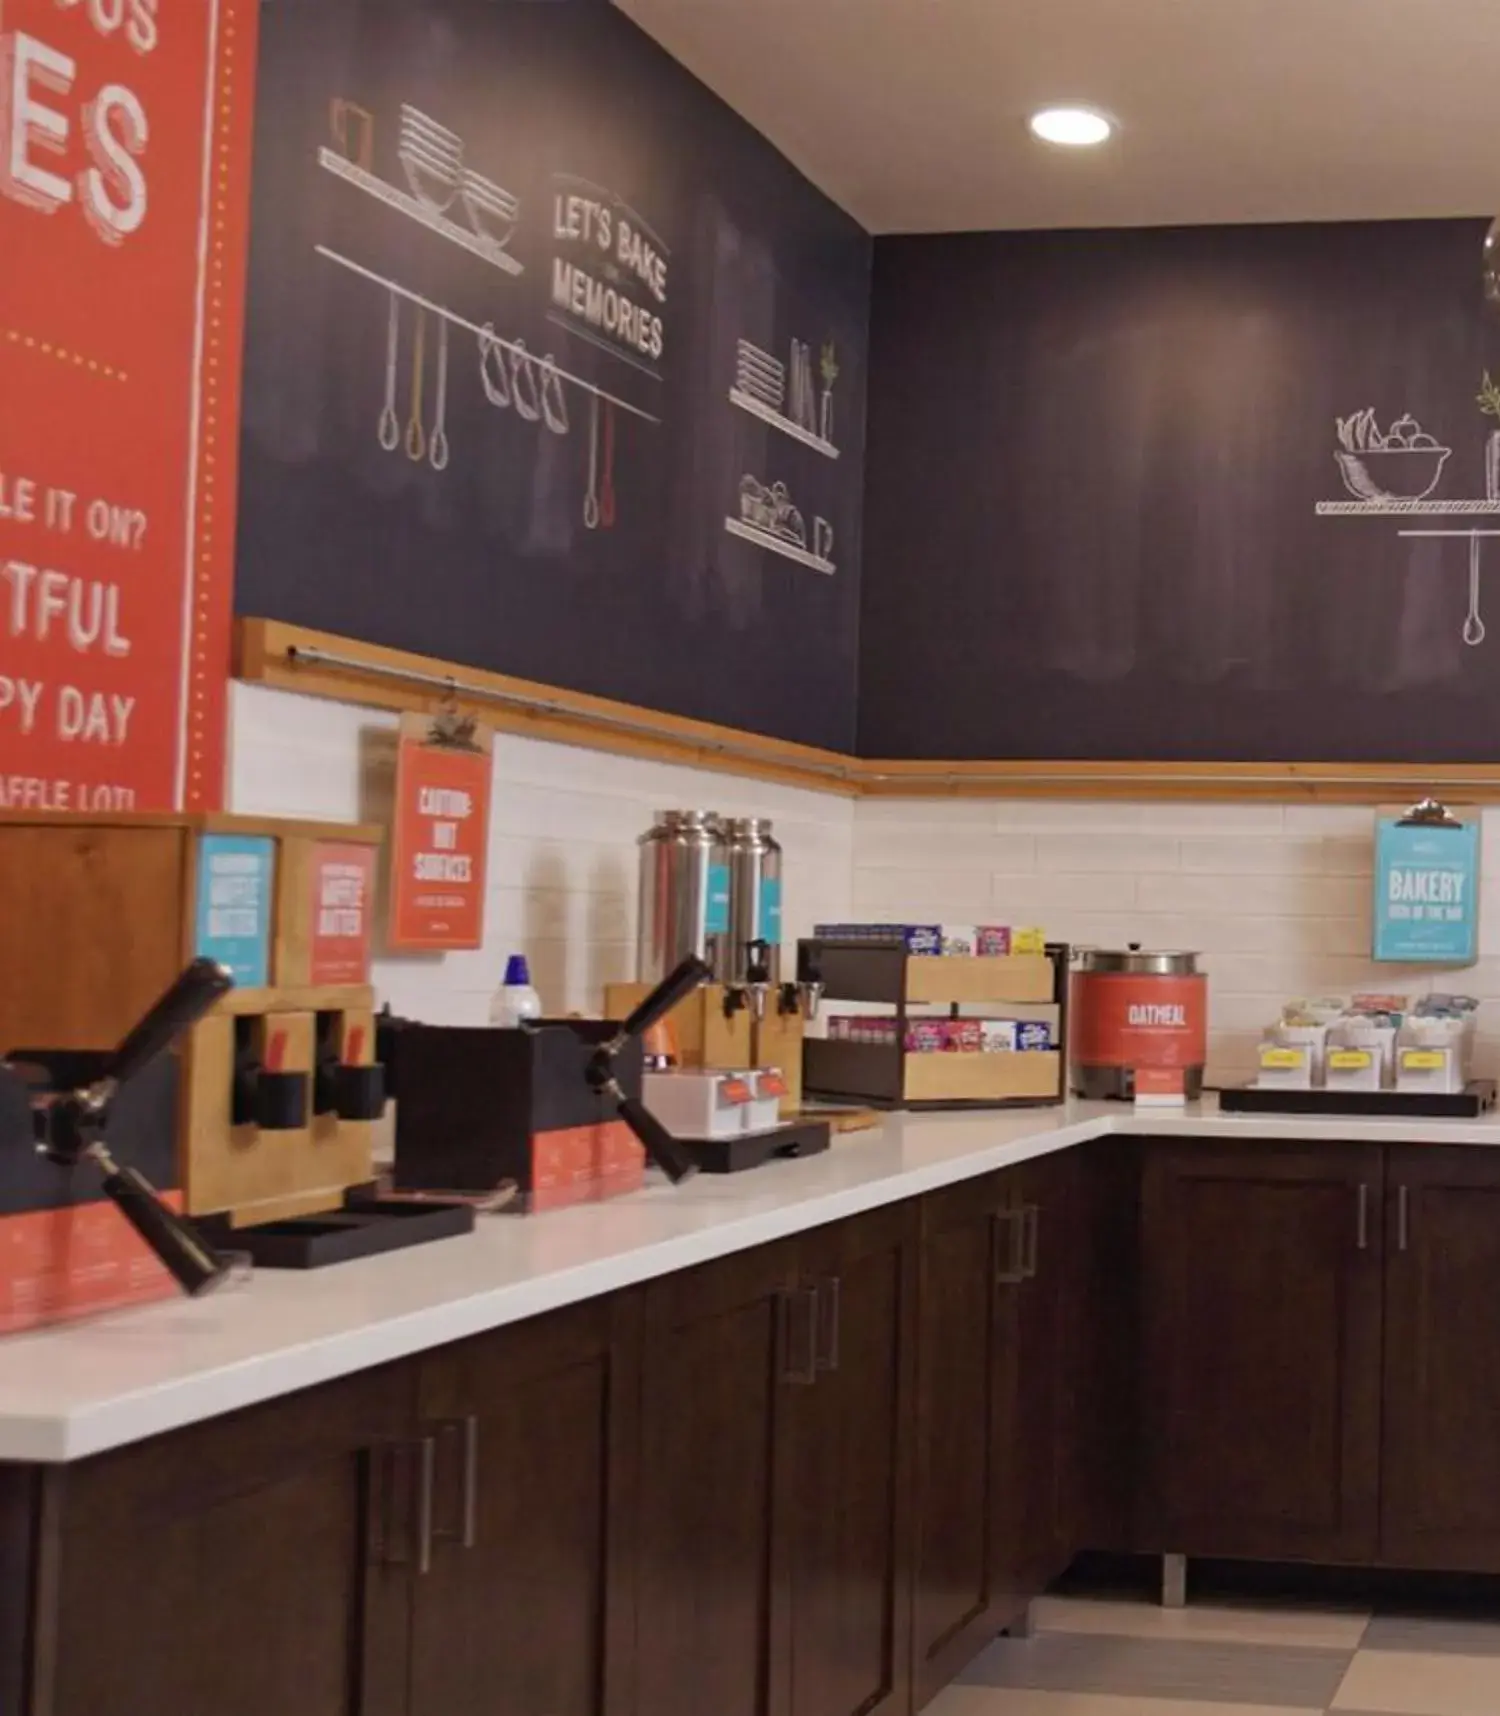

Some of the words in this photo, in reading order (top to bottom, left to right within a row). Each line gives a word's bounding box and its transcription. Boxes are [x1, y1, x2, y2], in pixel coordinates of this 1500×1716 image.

[553, 195, 612, 251] LET'S
[617, 219, 667, 302] BAKE
[552, 256, 664, 360] MEMORIES
[45, 487, 75, 533] IT
[86, 498, 147, 549] ON?
[3, 560, 131, 656] TFUL
[58, 684, 136, 746] DAY
[1388, 869, 1465, 903] BAKERY
[1128, 1004, 1186, 1026] OATMEAL
